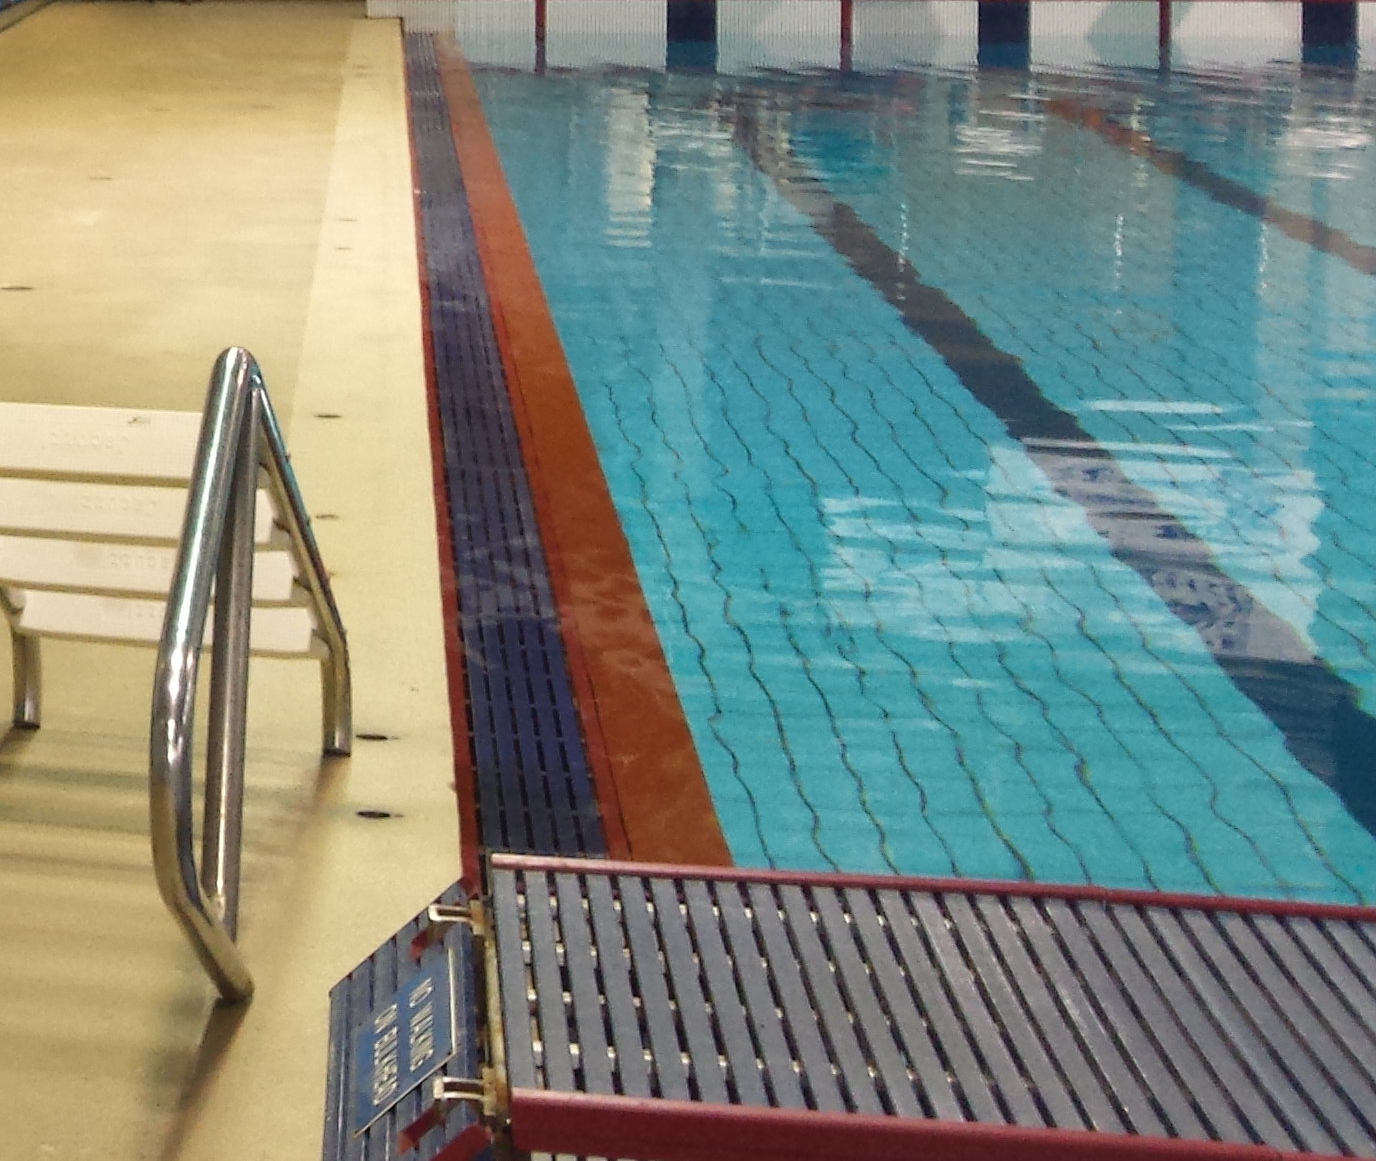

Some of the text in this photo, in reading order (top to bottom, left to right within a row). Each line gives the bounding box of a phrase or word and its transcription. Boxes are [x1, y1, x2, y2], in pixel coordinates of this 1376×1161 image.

[373, 1003, 399, 1107] ON BULKHEAD
[409, 977, 435, 1072] NO WALKING
